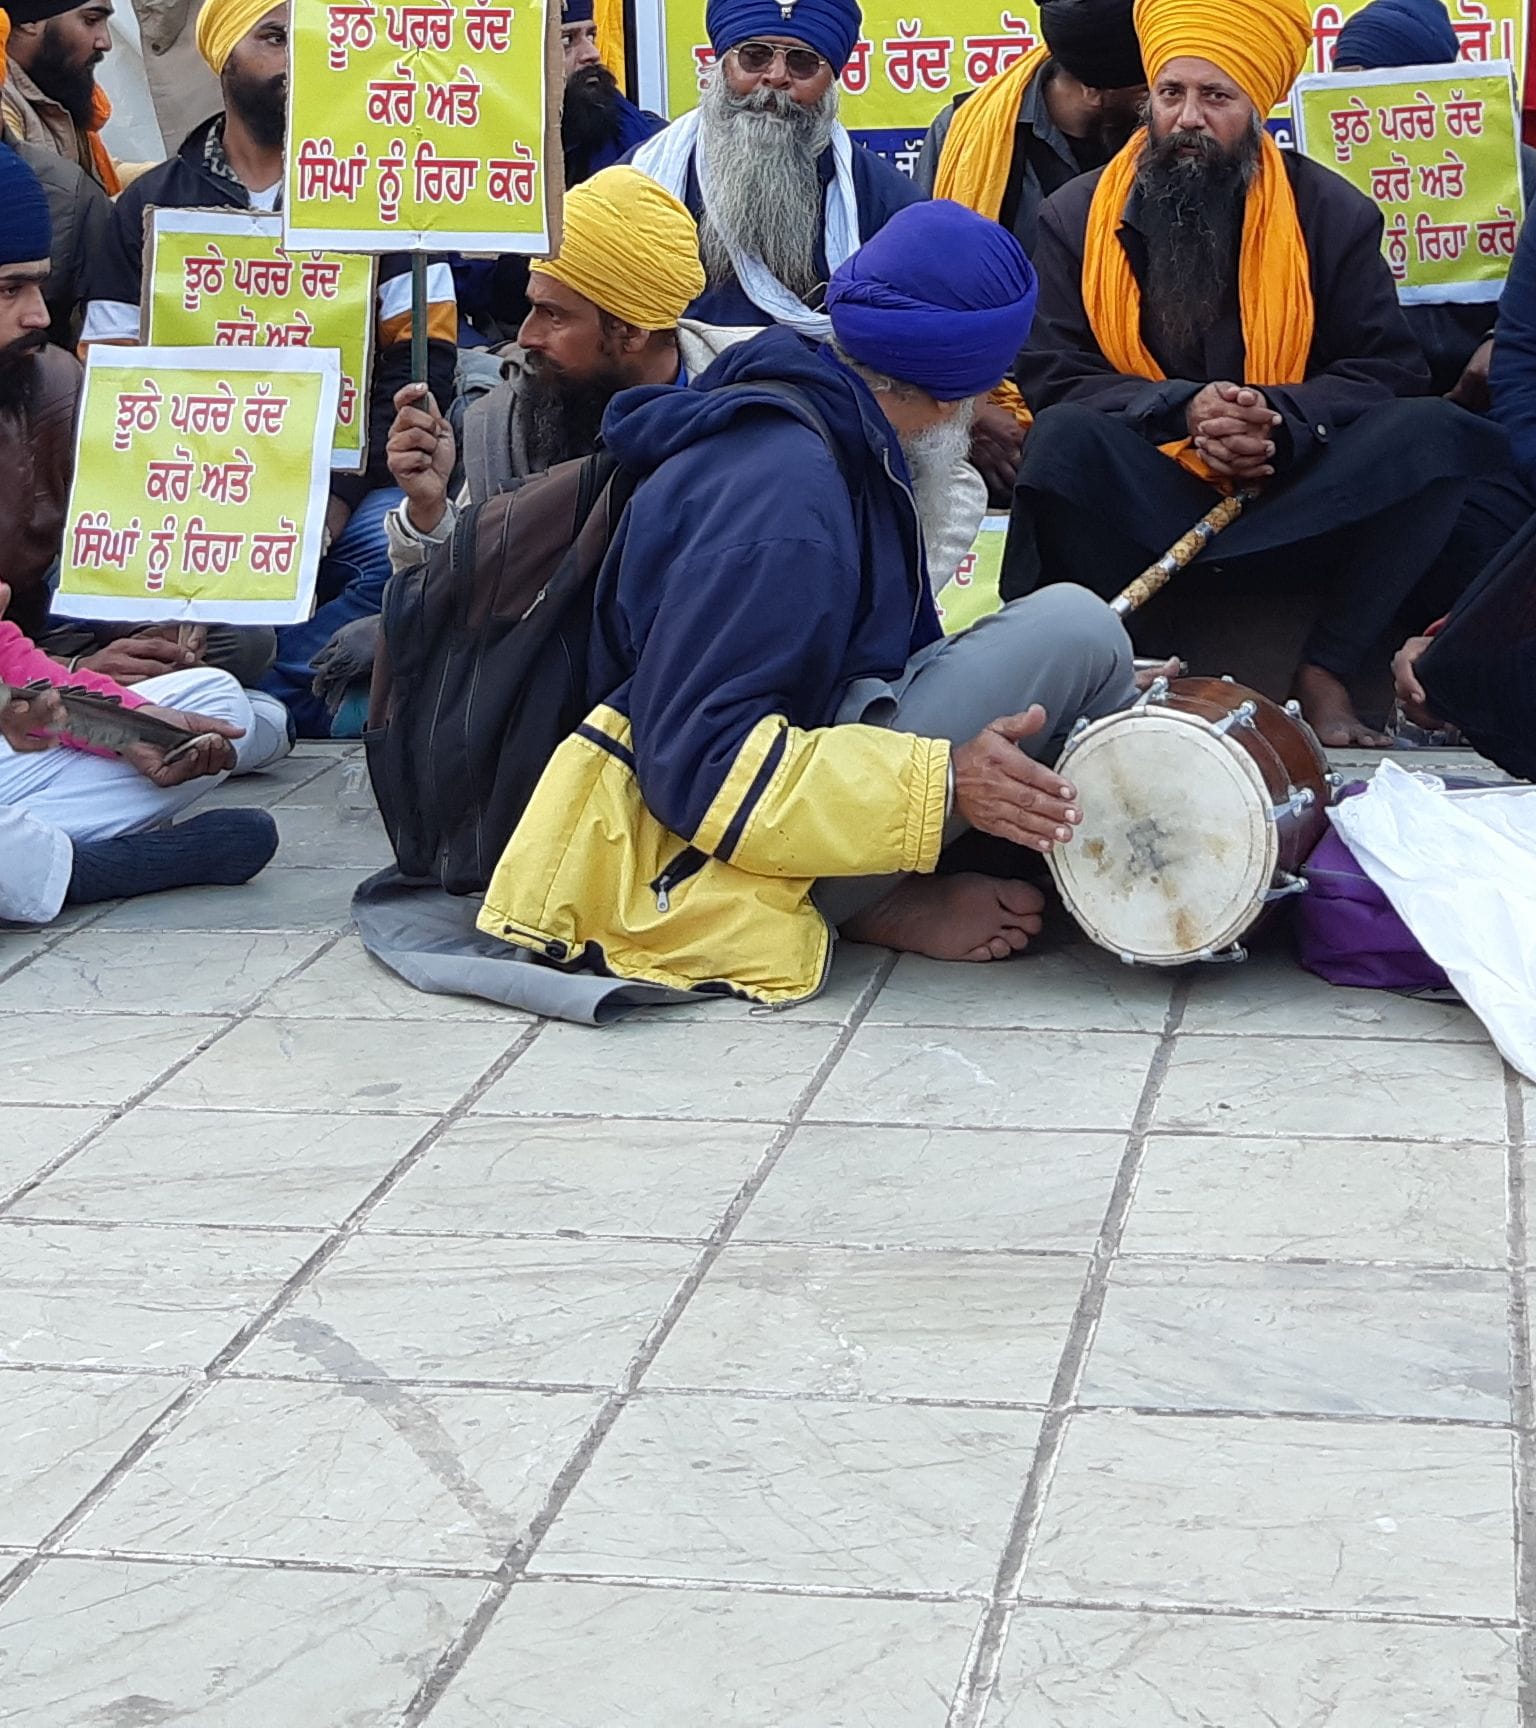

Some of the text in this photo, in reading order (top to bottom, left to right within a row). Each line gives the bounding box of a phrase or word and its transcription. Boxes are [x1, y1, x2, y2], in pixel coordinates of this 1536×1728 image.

[887, 20, 950, 89] ਰੱਦ
[368, 63, 481, 125] ਕਰੋ ਅਤੇ
[1331, 97, 1370, 162] ਝੂਠੇ
[1379, 92, 1435, 140] ਪਰਚੇ
[1445, 89, 1482, 138] ਰੱਦ
[298, 139, 536, 221] ਸਿੰਘਾਂ ਨੂੰ ਰਿਹਾ ਕਰੋ
[1371, 151, 1464, 201] ਕਰੋ ਅਤੇ
[184, 245, 341, 310] ਝੂਠੇ ਪਰਚੇ ਰੱਦ
[1387, 214, 1406, 279] ਨੂੰ
[1416, 214, 1467, 262] ਰਿਹਾ
[114, 380, 162, 450] ਝੂਠੇ
[170, 383, 236, 435] ਪਰਚੇ
[243, 384, 288, 435] ਰੱਦ
[147, 446, 254, 503] ਕਰੋ ਅਤੇ
[72, 513, 298, 591] ਸਿੰਘਾਂ ਨੂੰ ਰਿਹਾ ਕਰੋ
